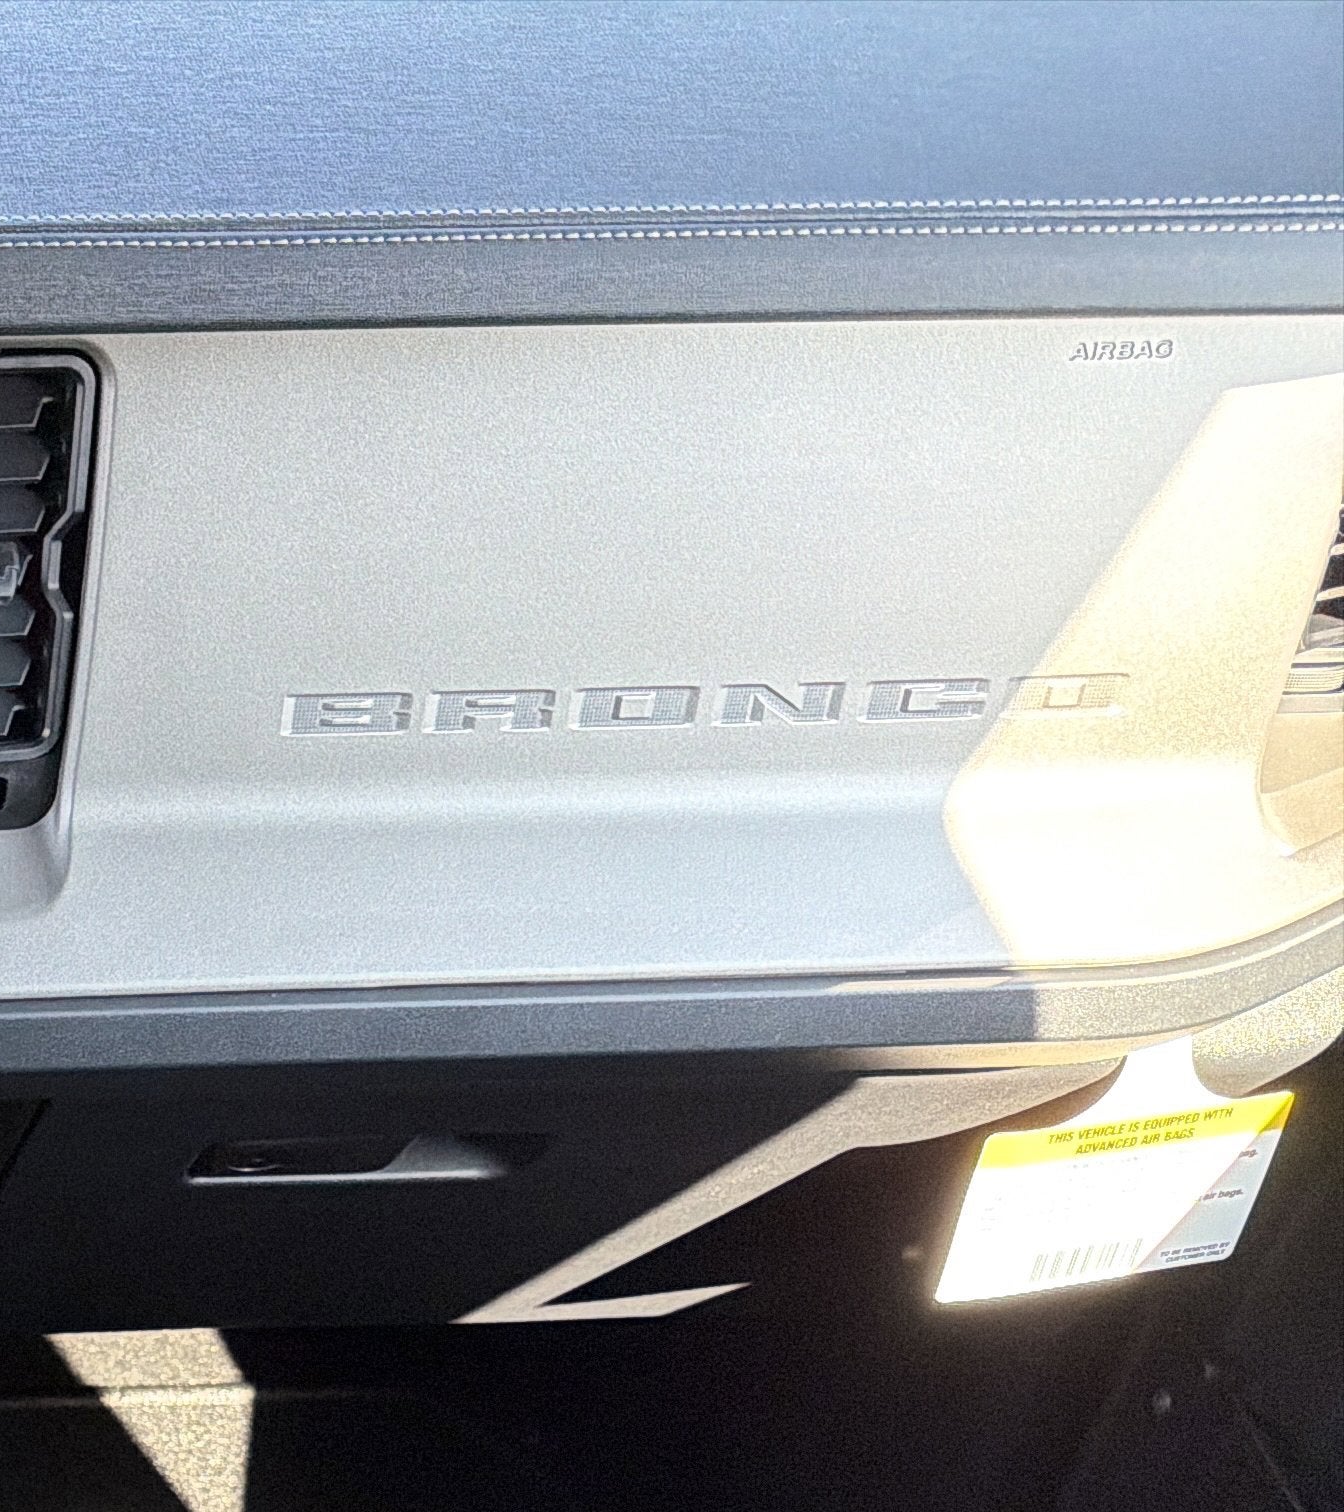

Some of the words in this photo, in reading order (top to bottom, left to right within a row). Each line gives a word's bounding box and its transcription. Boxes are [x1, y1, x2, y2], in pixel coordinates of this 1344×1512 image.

[1068, 339, 1174, 361] AIRBAG
[280, 672, 1132, 737] BRONCO
[1048, 1131, 1075, 1145] THIS
[1078, 1123, 1127, 1141] VEHICLE
[1127, 1121, 1141, 1133] IS
[1143, 1112, 1201, 1131] EQUIPPED
[1203, 1107, 1234, 1121] WITH
[1075, 1136, 1138, 1155] ADVANCED
[1140, 1132, 1161, 1145] AIR
[1163, 1127, 1196, 1142] BAGS
